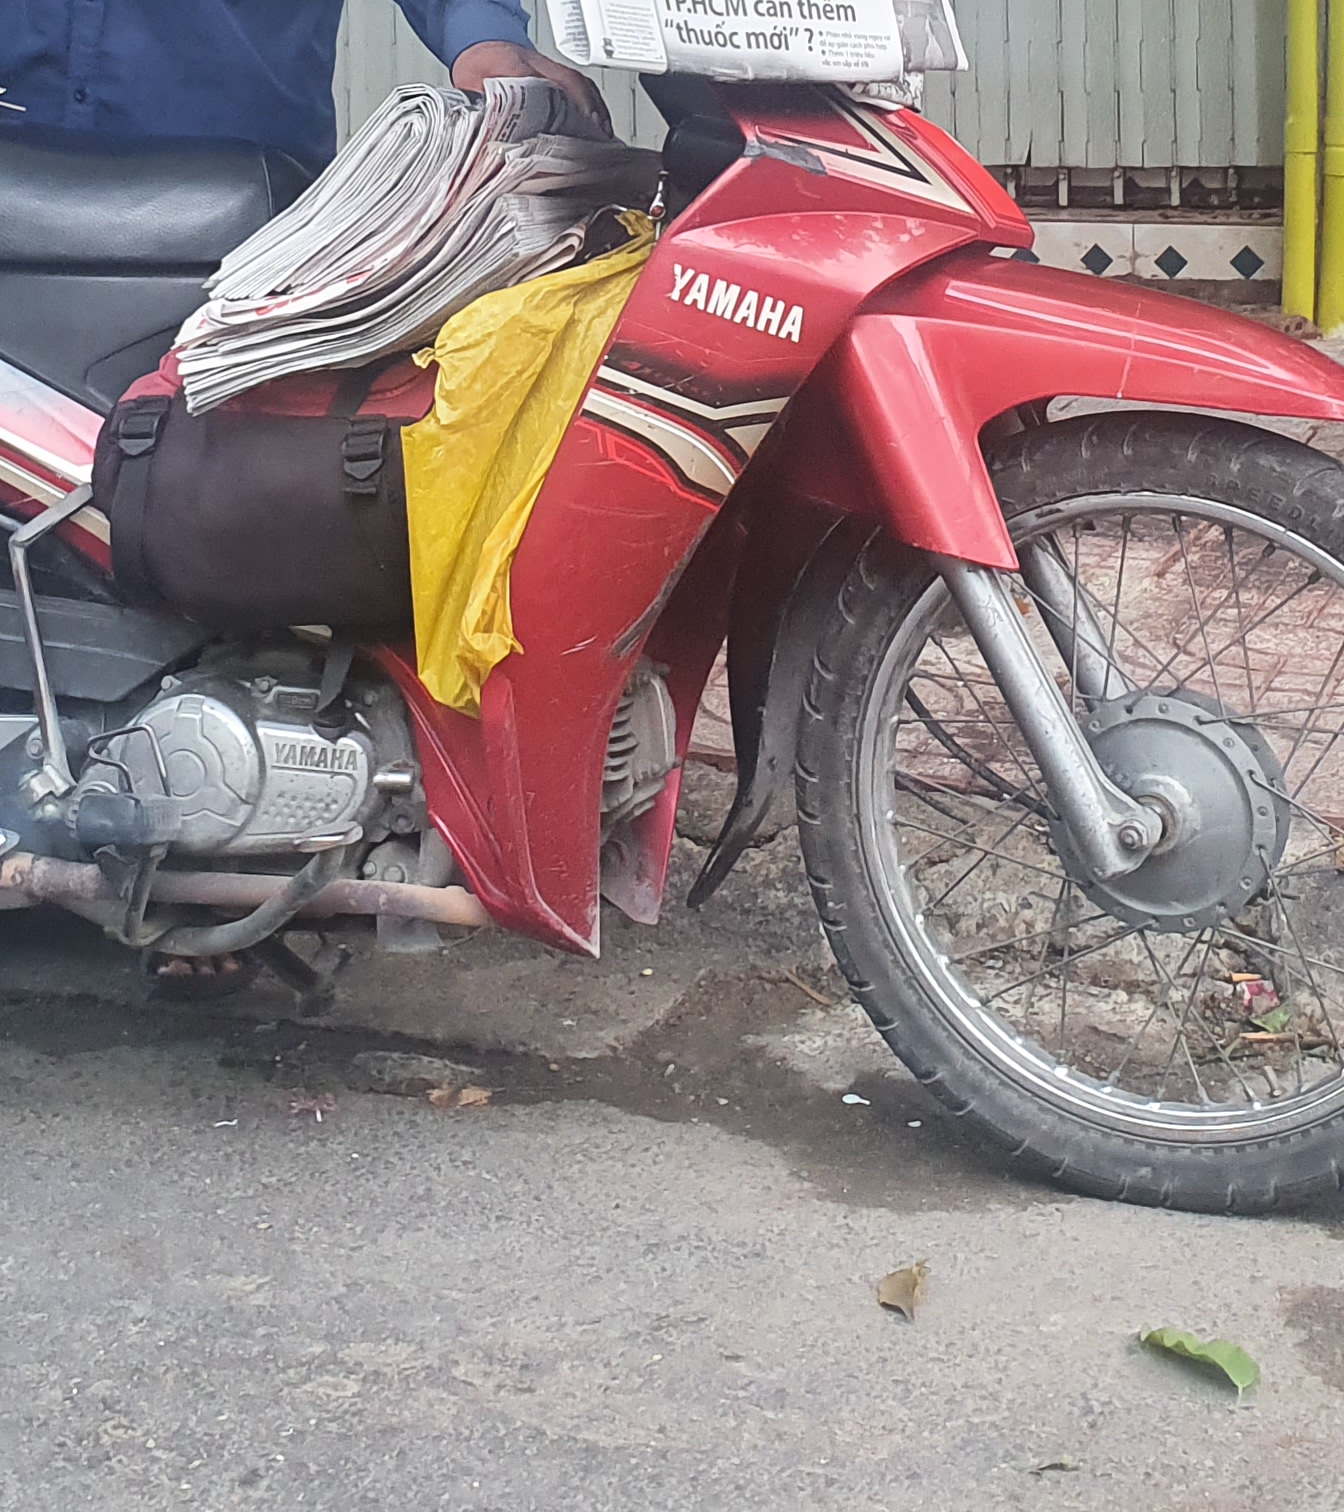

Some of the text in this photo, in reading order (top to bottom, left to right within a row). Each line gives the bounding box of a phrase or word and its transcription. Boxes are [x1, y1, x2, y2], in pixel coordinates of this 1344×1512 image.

[804, 27, 814, 53] ?
[669, 262, 804, 344] YAMAHA
[275, 742, 358, 772] YAMAHA
